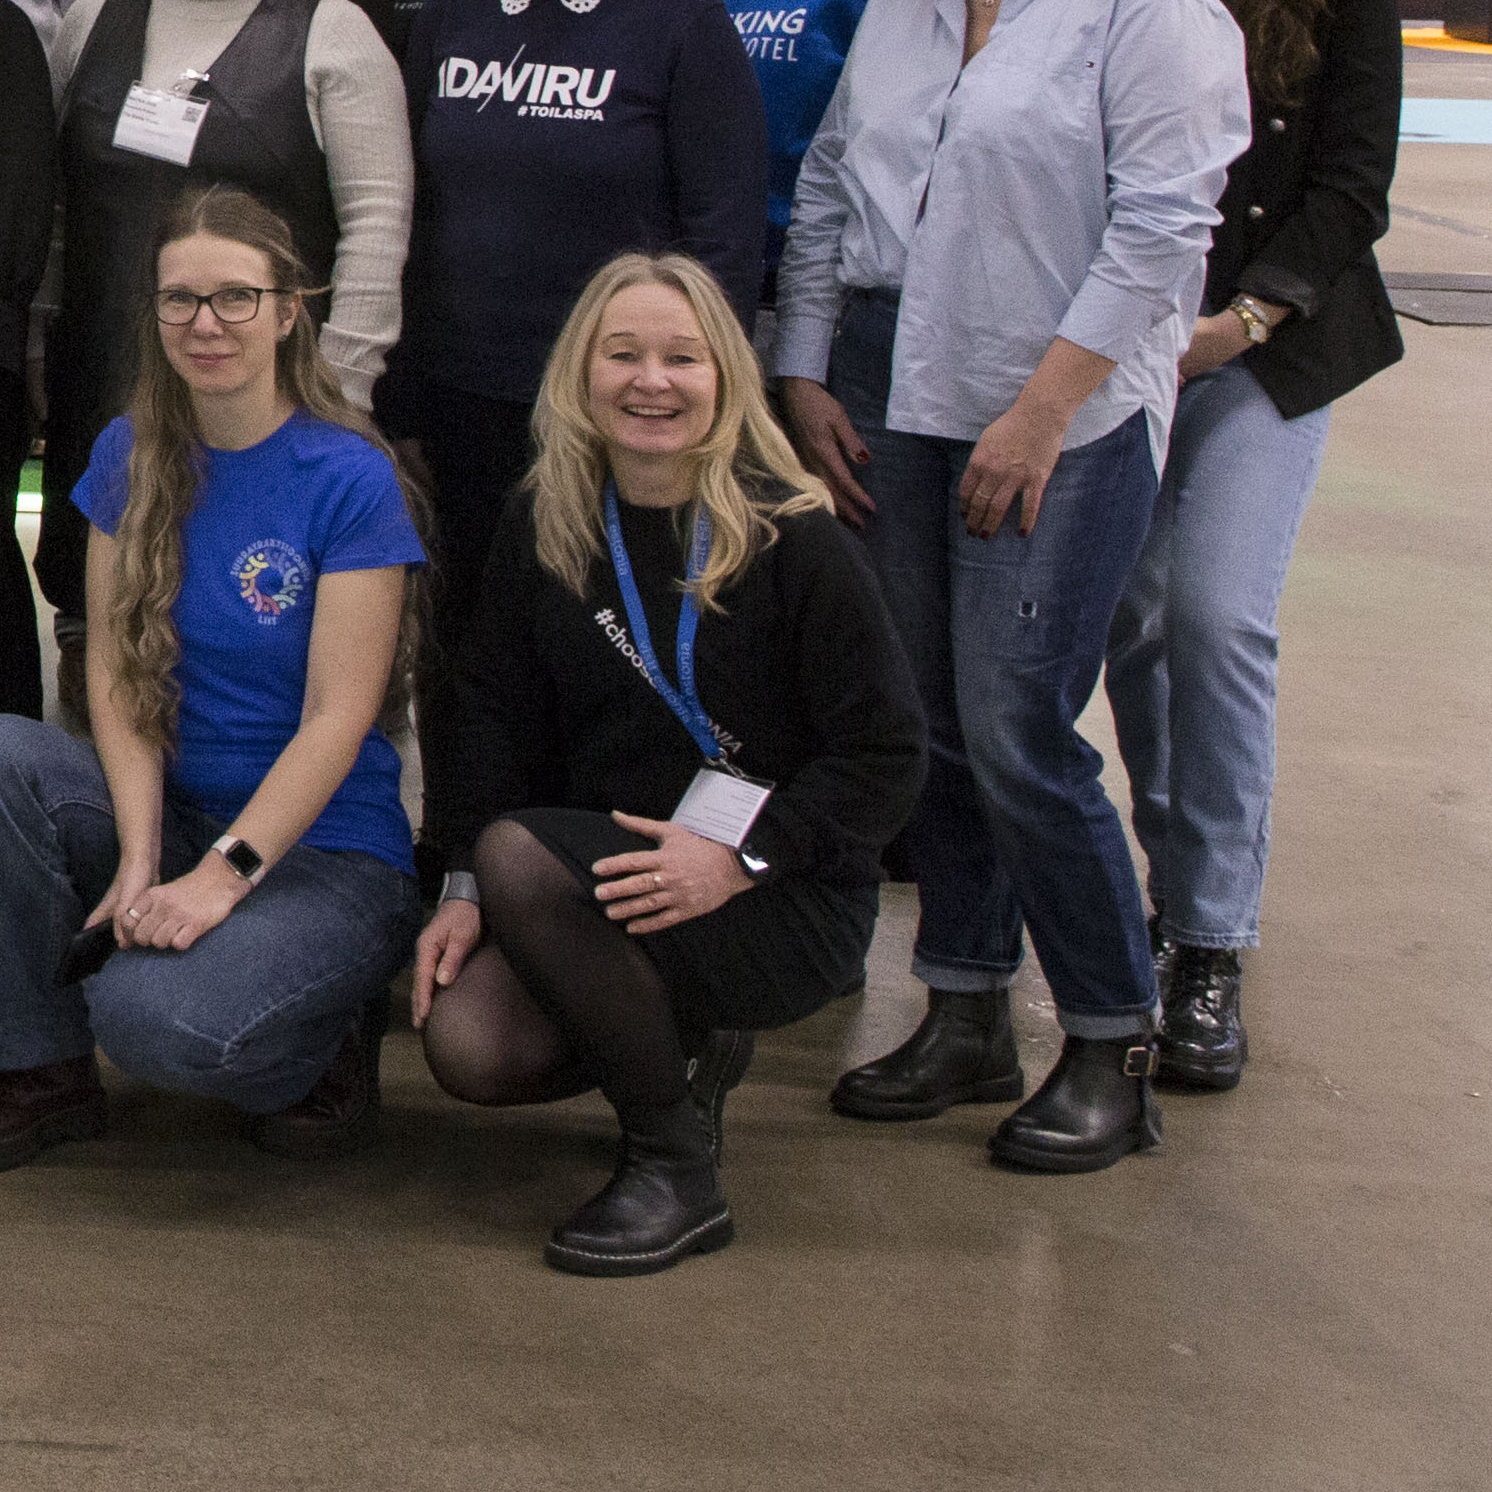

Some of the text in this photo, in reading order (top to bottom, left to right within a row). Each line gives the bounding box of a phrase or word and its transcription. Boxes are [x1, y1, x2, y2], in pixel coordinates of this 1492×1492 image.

[730, 8, 807, 35] KING
[742, 37, 799, 62] OTEL
[438, 45, 617, 113] IDAVIRU
[518, 105, 604, 121] #TOILASPA
